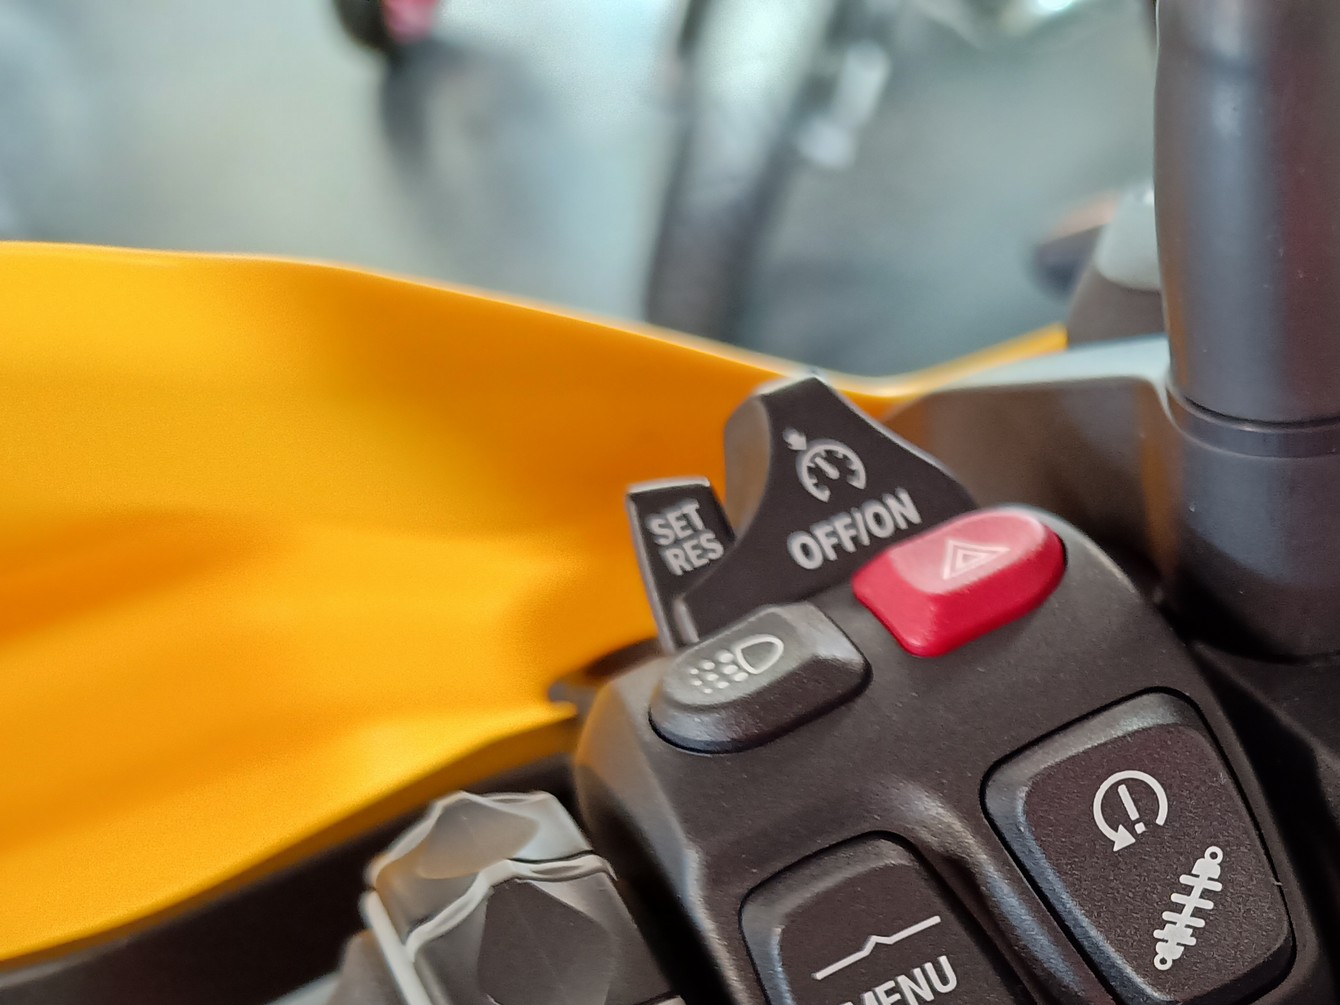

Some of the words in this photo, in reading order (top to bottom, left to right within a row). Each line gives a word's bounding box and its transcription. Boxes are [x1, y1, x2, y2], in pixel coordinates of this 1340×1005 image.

[646, 499, 705, 546] SET
[787, 487, 921, 570] OFF/ON
[660, 530, 724, 576] RES
